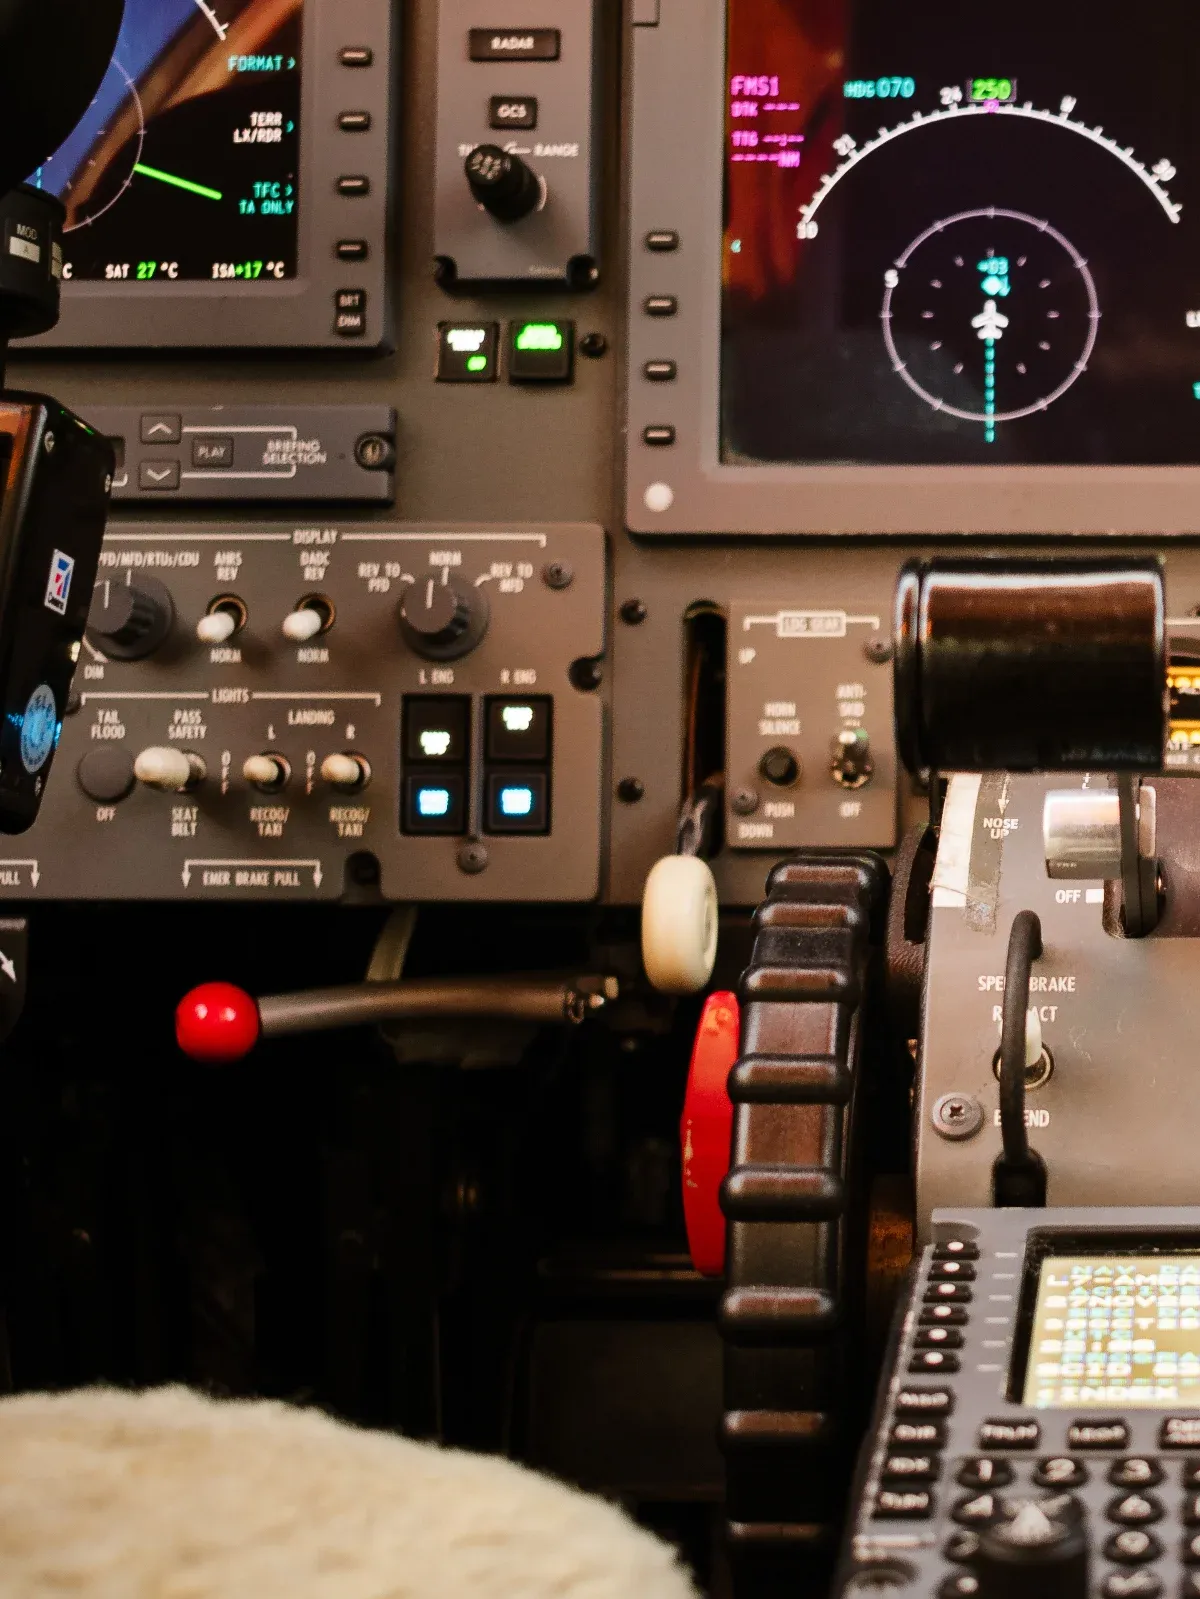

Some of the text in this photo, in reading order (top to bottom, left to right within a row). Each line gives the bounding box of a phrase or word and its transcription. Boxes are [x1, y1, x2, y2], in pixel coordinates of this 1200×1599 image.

[228, 56, 283, 72] FORMAT
[731, 76, 778, 96] FMS1
[876, 77, 915, 98] 070
[972, 78, 1012, 100] 250
[251, 112, 282, 127] TERR
[253, 182, 280, 199] TFC
[239, 200, 294, 215] TA ONLY
[105, 263, 129, 279] SAT
[137, 262, 156, 279] 27
[198, 447, 226, 458] PLAY
[262, 452, 327, 464] SELECTION
[292, 530, 338, 544] DISPLAY
[212, 689, 249, 704] LIGHTS
[98, 710, 120, 724] TAIL
[174, 709, 202, 724] PASS
[288, 710, 335, 725] LANDING
[91, 724, 125, 739] FLOOD
[168, 725, 207, 740] SAFETY
[96, 807, 116, 821] OFF
[172, 807, 199, 821] SEAT
[171, 822, 197, 837] BELT
[259, 823, 283, 836] TAXI
[738, 823, 773, 838] DOWN
[983, 817, 1019, 830] NOSE
[991, 828, 1009, 839] UP
[235, 871, 269, 887] BRAKE
[274, 871, 300, 886] PULL
[1055, 890, 1081, 904] OFF
[1030, 974, 1076, 994] BRAKE
